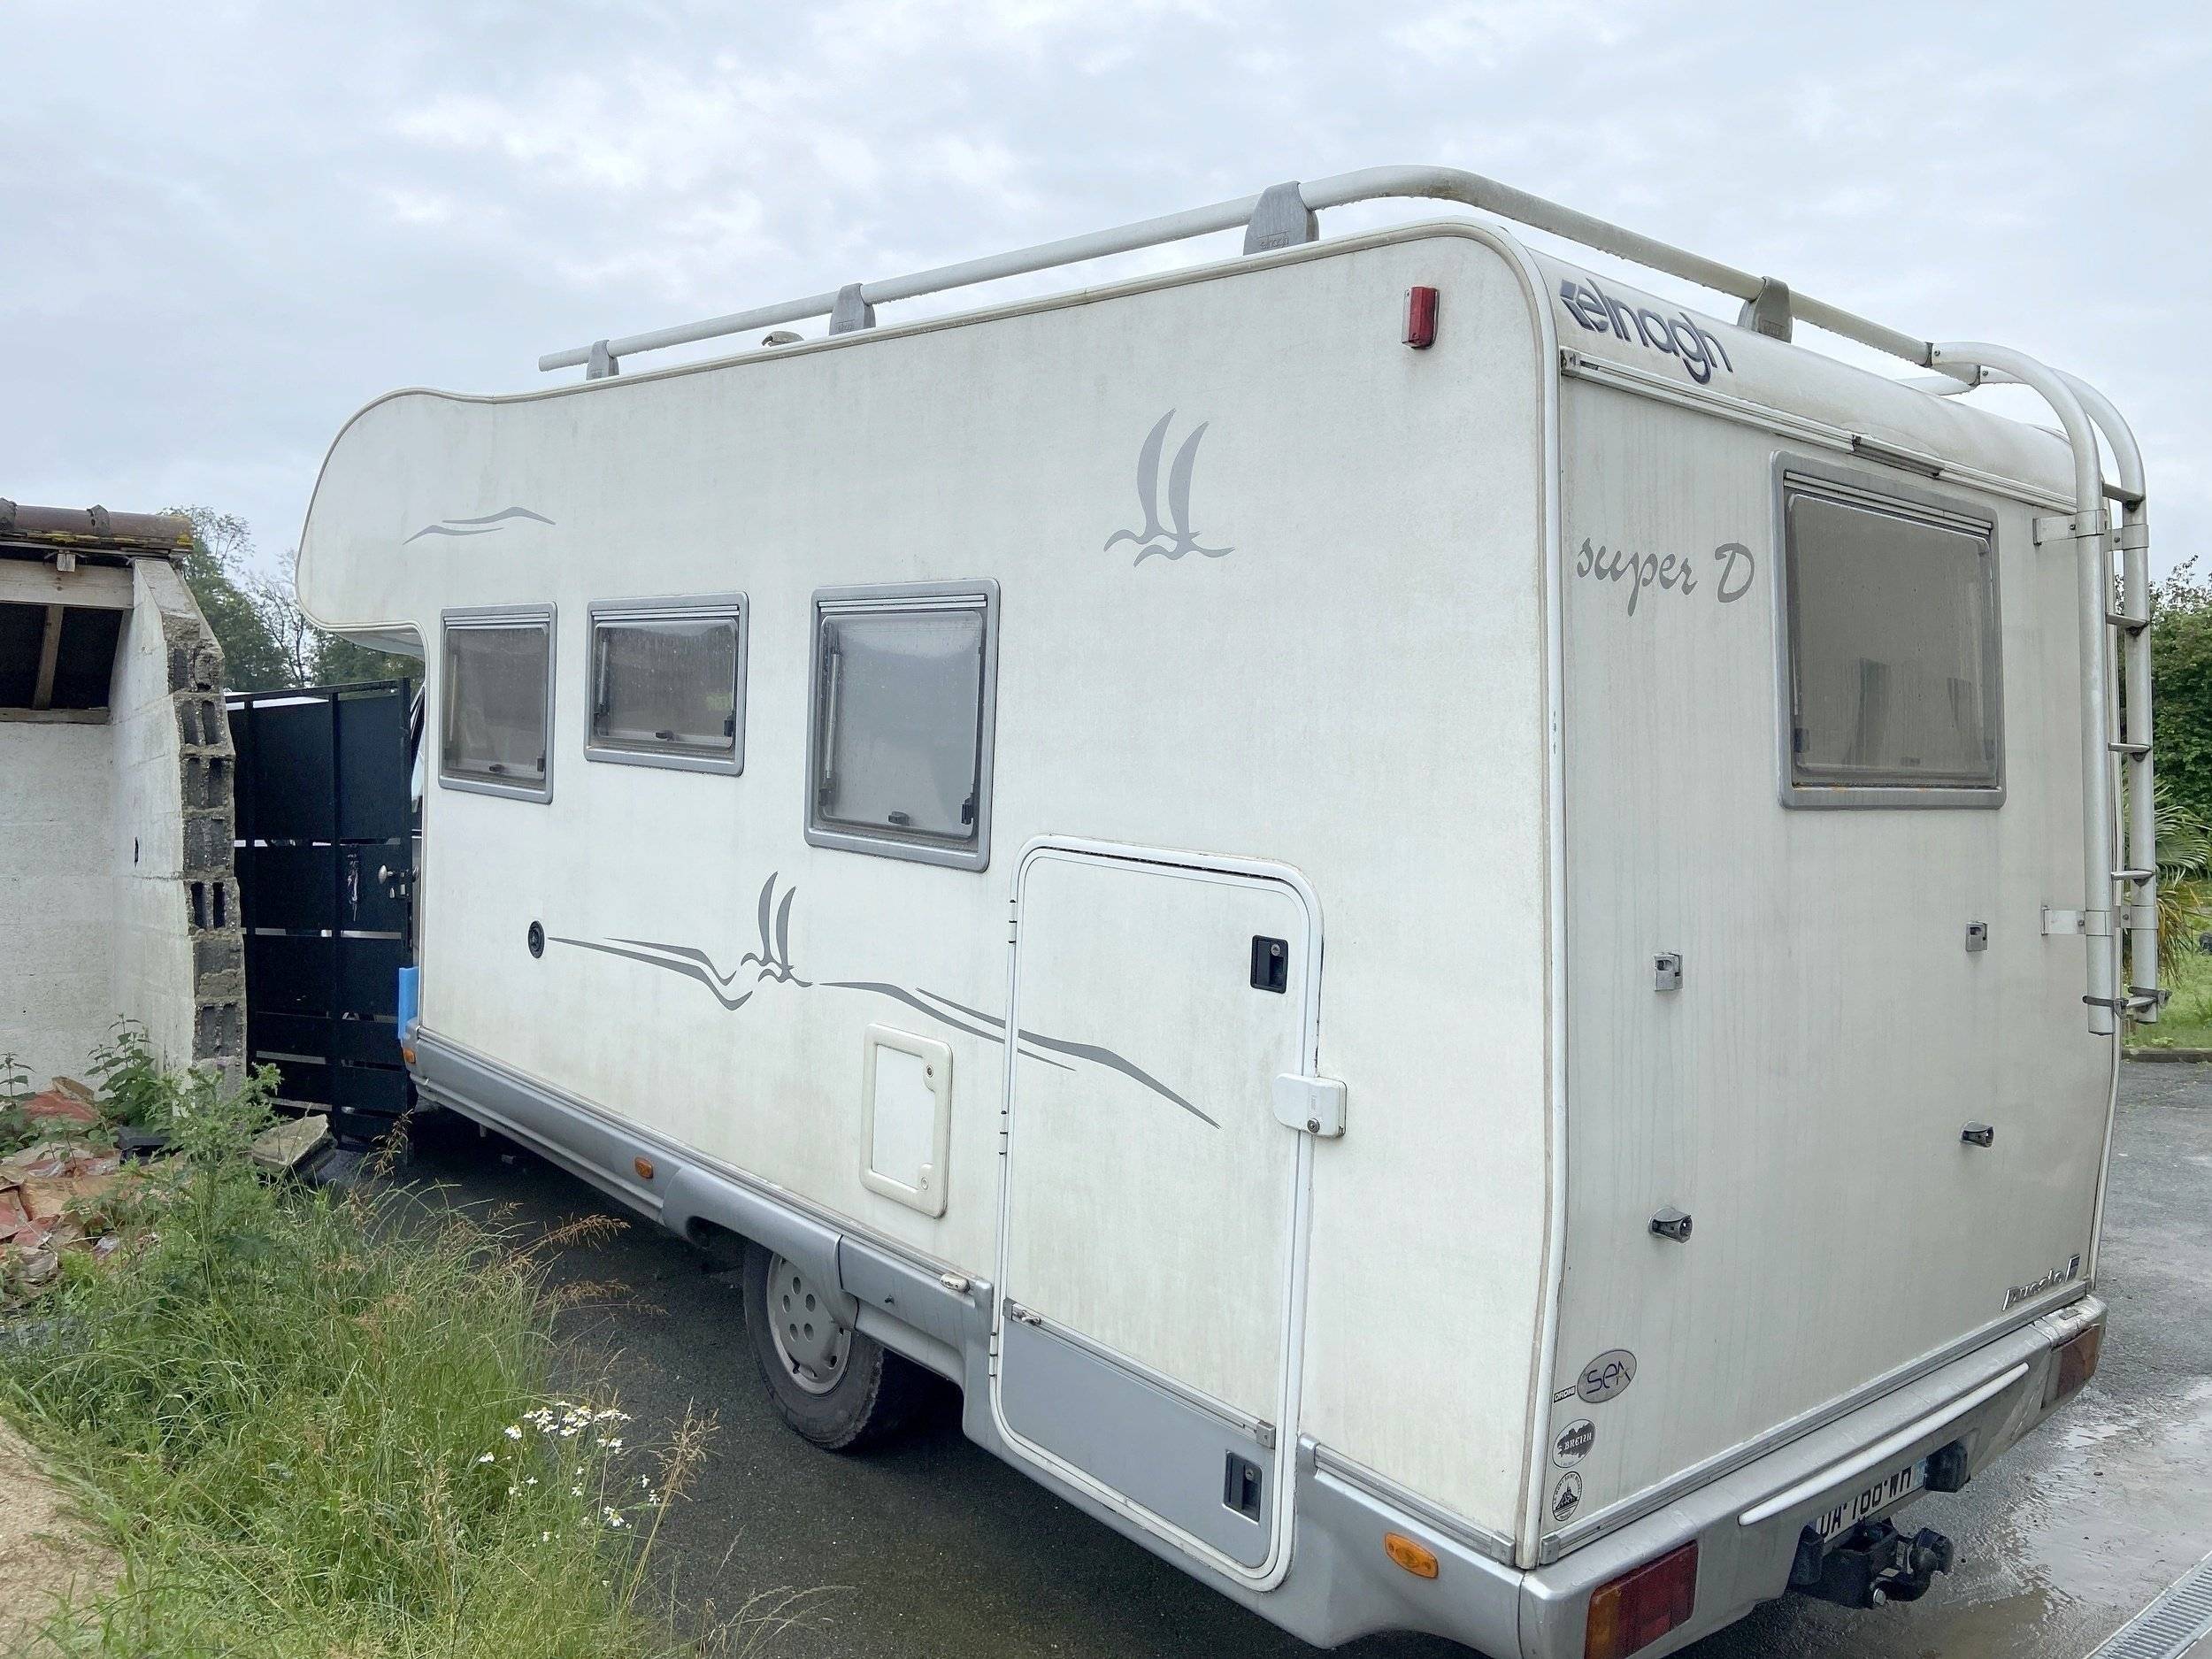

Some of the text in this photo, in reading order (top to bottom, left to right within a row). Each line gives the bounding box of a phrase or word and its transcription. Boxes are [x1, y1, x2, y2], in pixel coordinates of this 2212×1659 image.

[1560, 278, 1733, 385] elnagh
[1577, 537, 1755, 617] super D
